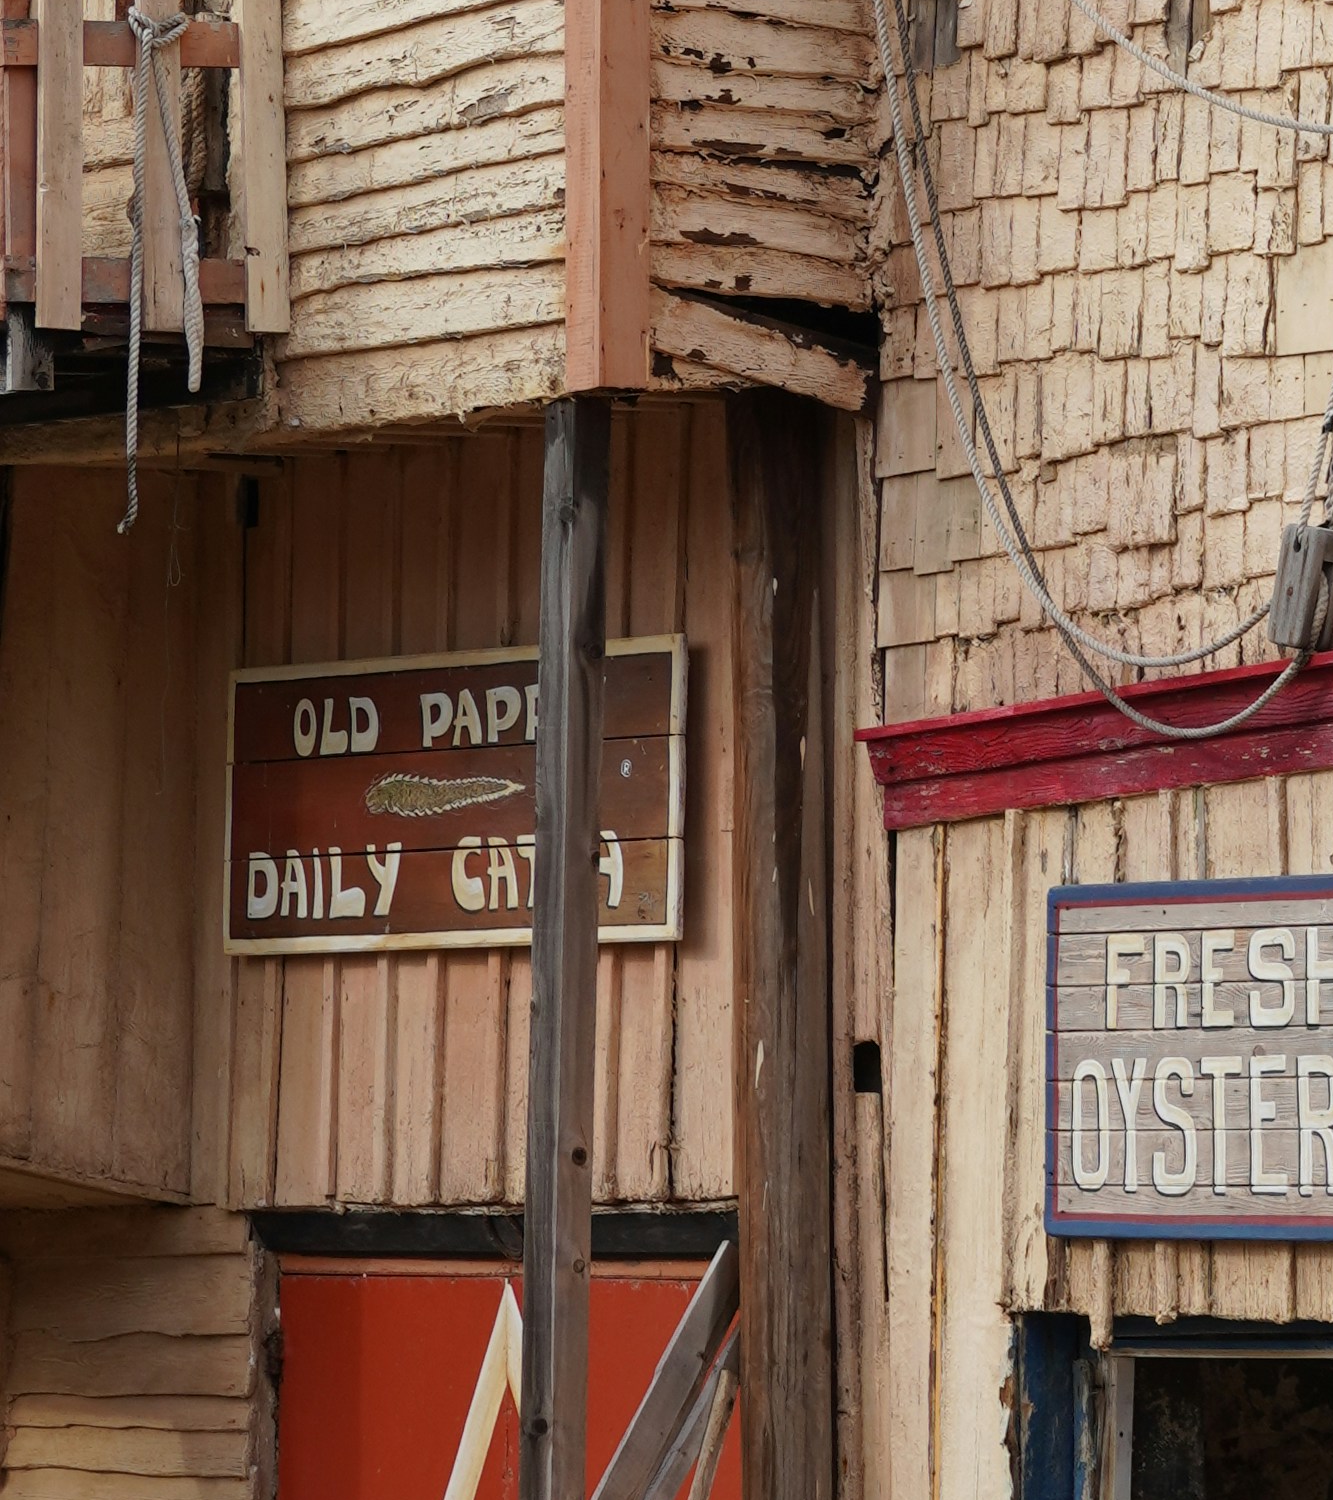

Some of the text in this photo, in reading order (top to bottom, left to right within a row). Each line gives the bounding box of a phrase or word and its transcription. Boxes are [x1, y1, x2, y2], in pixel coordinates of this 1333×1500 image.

[293, 695, 380, 757] OLD
[247, 830, 624, 920] DAILY CAH
